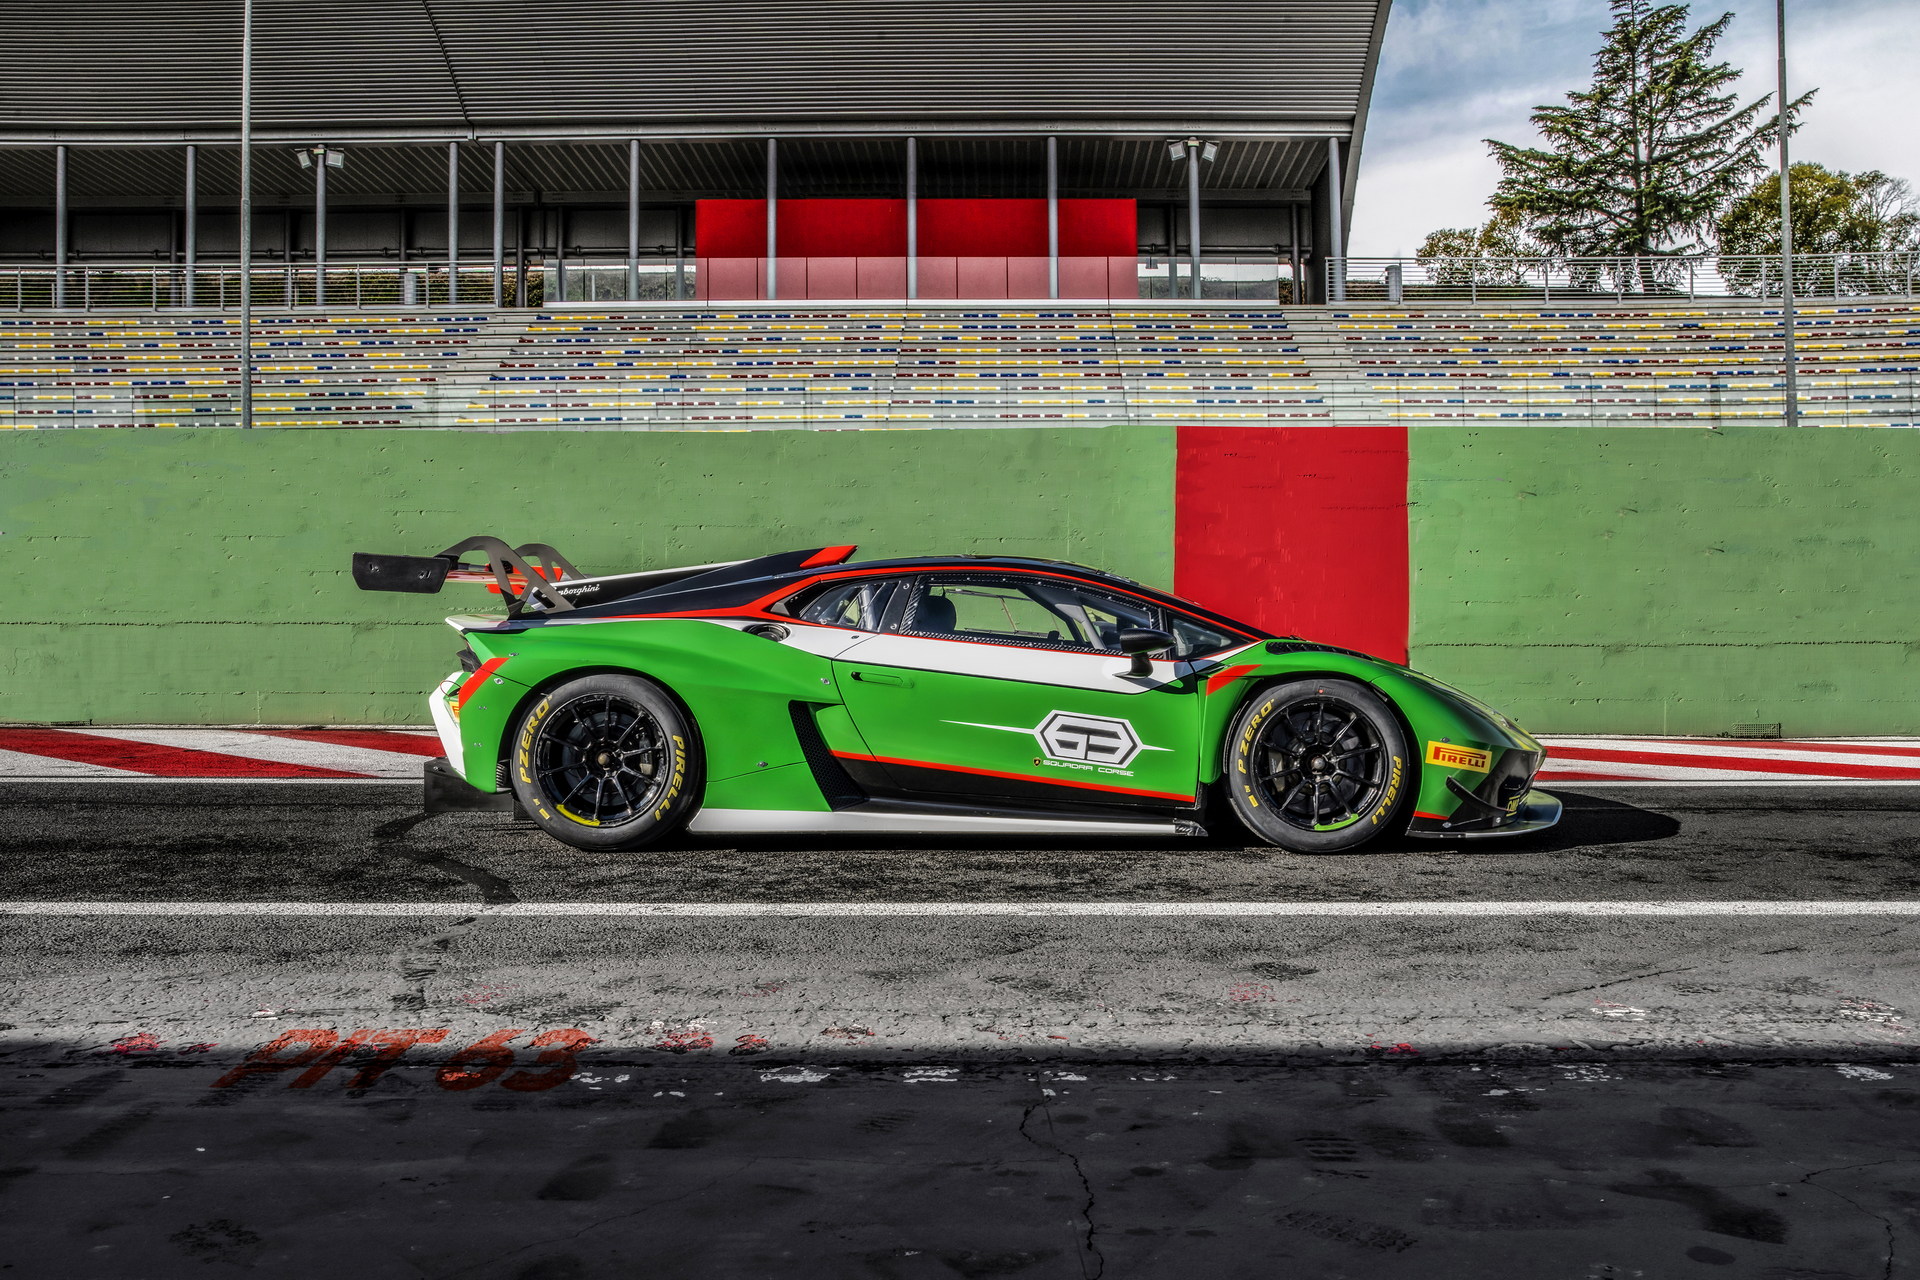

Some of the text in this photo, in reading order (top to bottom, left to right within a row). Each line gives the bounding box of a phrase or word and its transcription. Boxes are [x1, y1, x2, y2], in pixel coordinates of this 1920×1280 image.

[654, 734, 687, 822] PIRELLI
[1042, 759, 1134, 777] SQUADRA CORSE
[1432, 745, 1487, 769] PIRELLI
[1371, 755, 1403, 825] PIRELLI
[436, 1028, 594, 1092] 63
